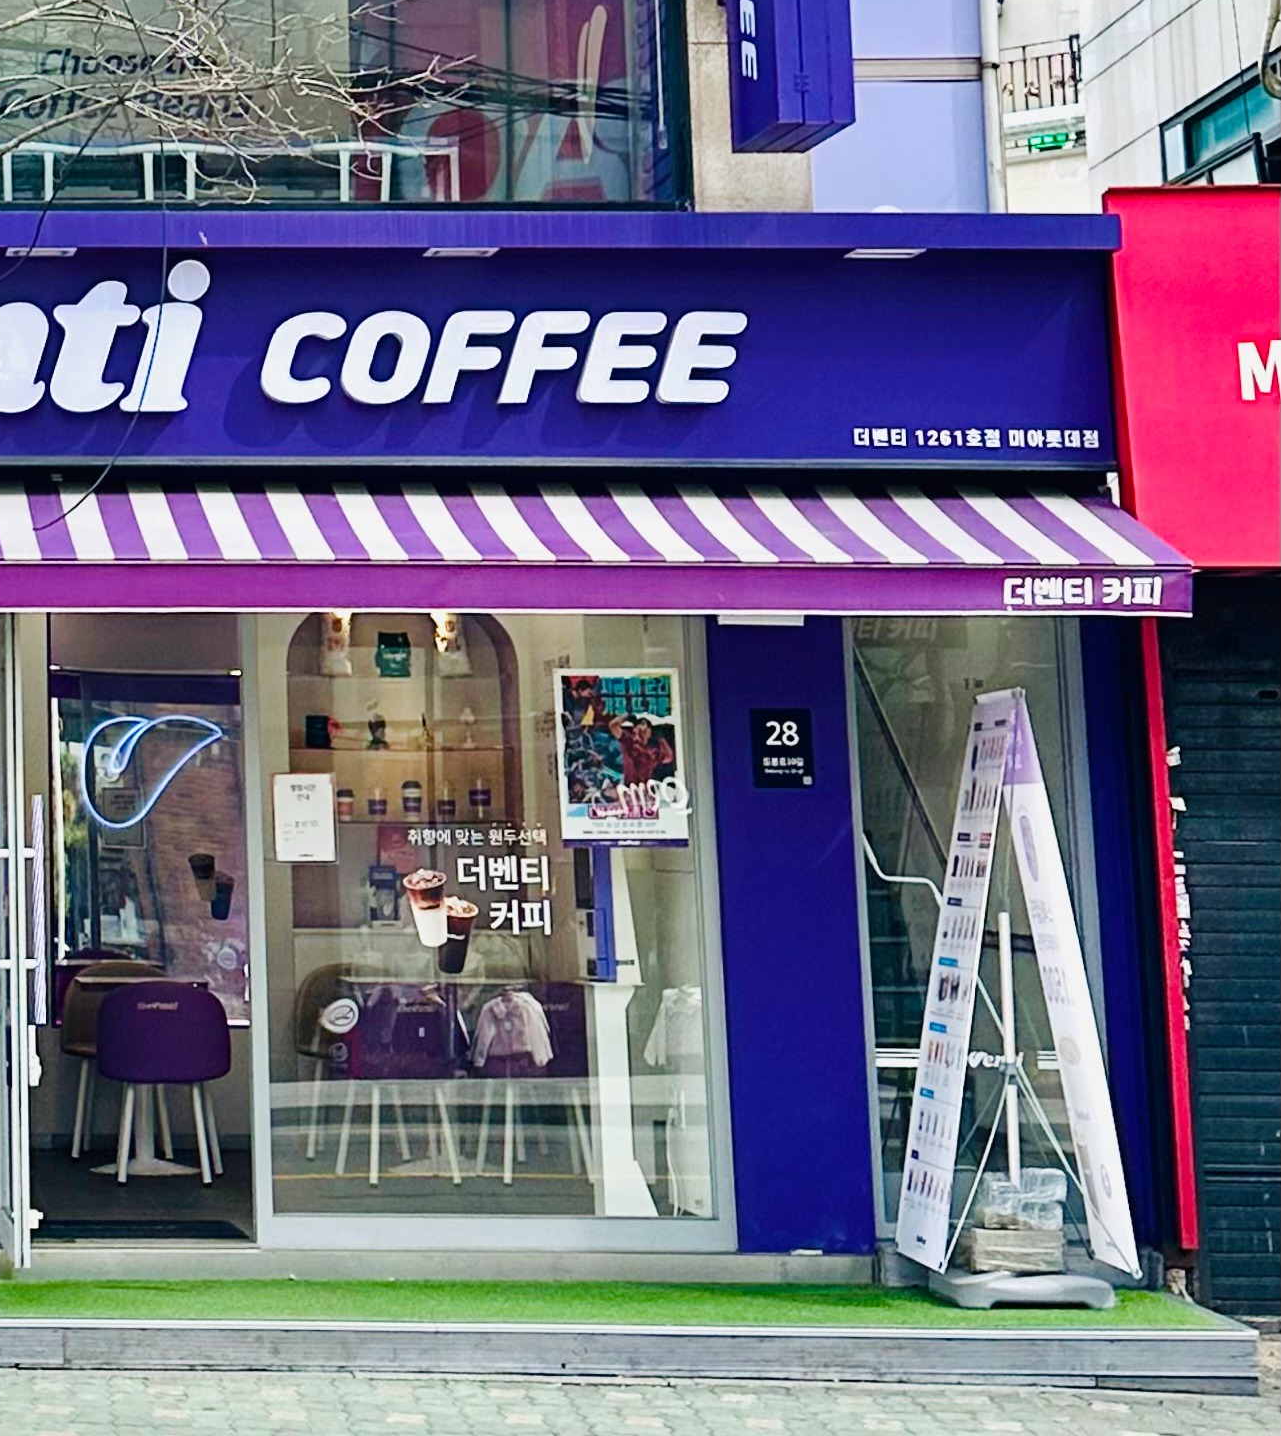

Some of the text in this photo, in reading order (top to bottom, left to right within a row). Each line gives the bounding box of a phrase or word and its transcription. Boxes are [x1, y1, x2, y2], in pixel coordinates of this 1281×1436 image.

[40, 48, 153, 76] Choose
[261, 310, 748, 405] COFFEE
[853, 427, 1100, 448] 더벤티 1261호점 미아롯데점
[1003, 576, 1163, 606] 더벤티 커피
[765, 720, 800, 746] 28
[407, 828, 547, 846] 취향에 맞는 원두선택
[457, 855, 550, 892] 더벤티
[489, 900, 552, 935] 커피
